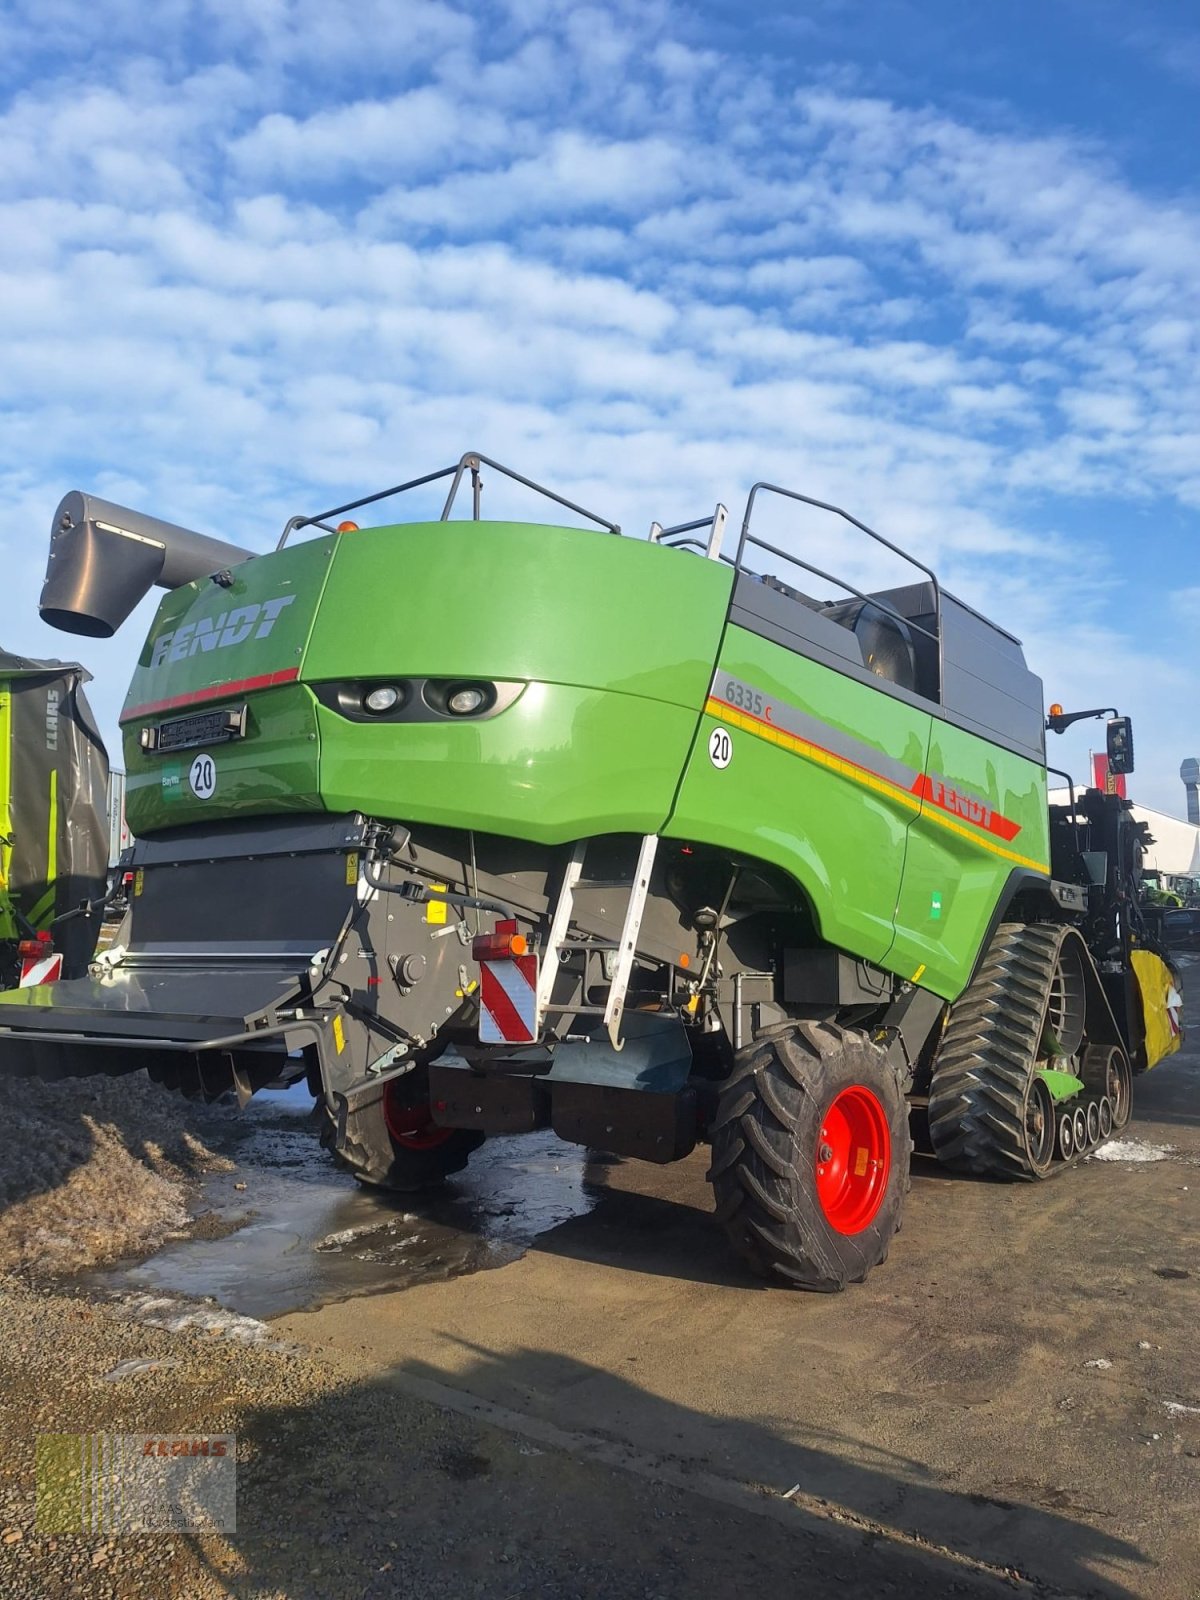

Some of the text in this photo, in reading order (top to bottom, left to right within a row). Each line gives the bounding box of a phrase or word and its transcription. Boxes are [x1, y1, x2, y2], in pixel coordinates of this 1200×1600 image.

[151, 595, 297, 669] FENDT
[46, 690, 59, 751] CLAAS
[726, 681, 762, 715] 6335
[713, 733, 729, 762] 20
[195, 760, 212, 791] 20
[931, 771, 994, 829] FENDT
